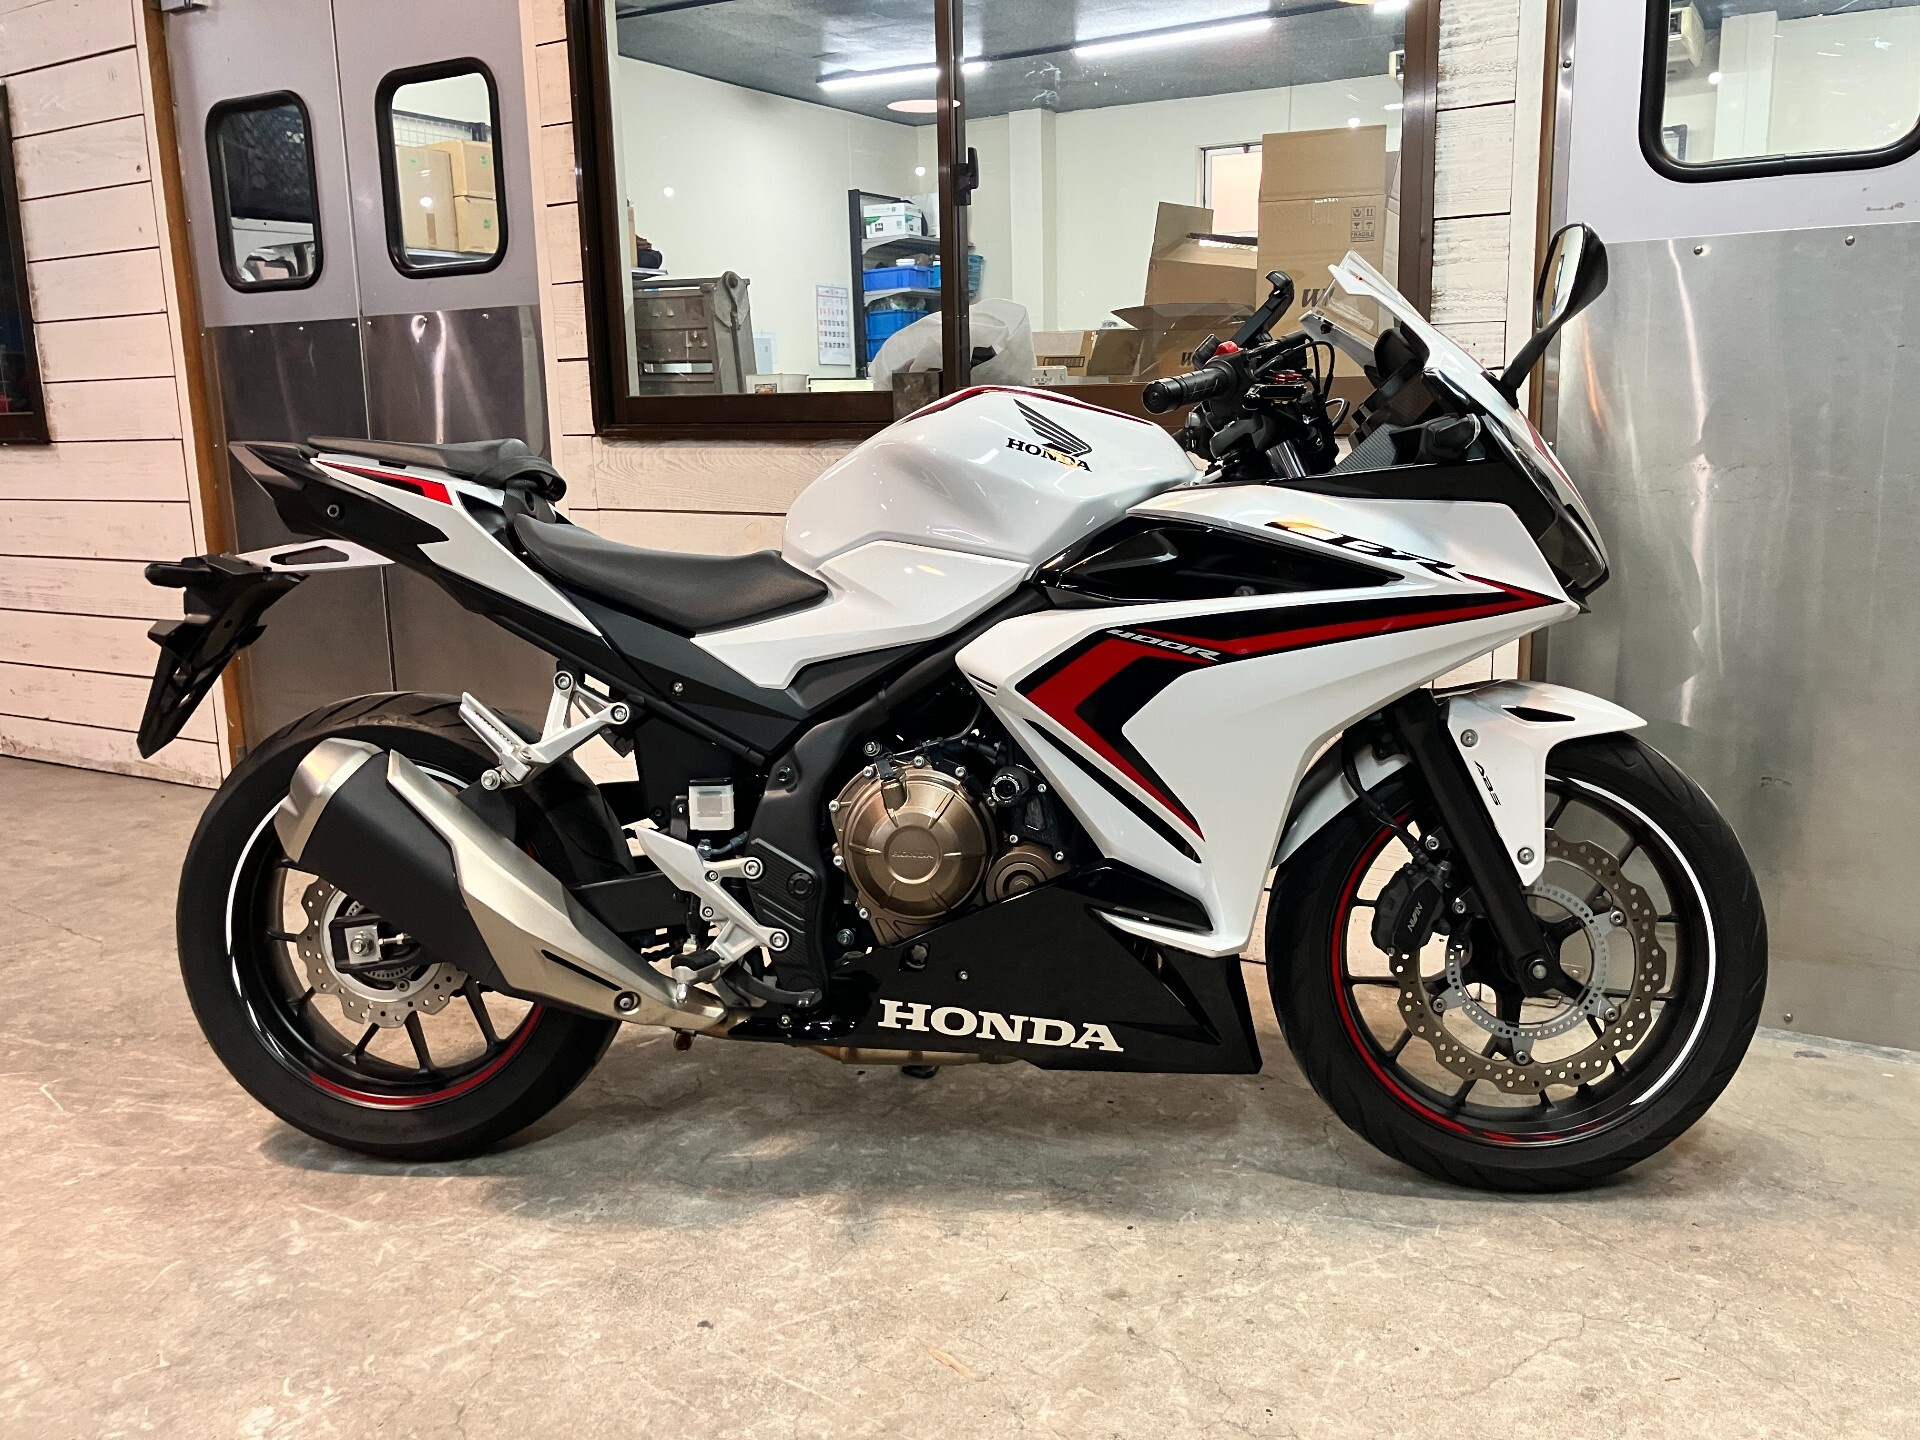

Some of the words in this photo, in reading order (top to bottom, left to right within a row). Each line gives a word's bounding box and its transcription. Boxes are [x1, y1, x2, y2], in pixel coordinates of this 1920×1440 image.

[1106, 629, 1220, 662] 400R
[1474, 760, 1501, 805] ABS
[878, 999, 1124, 1052] HONDA
